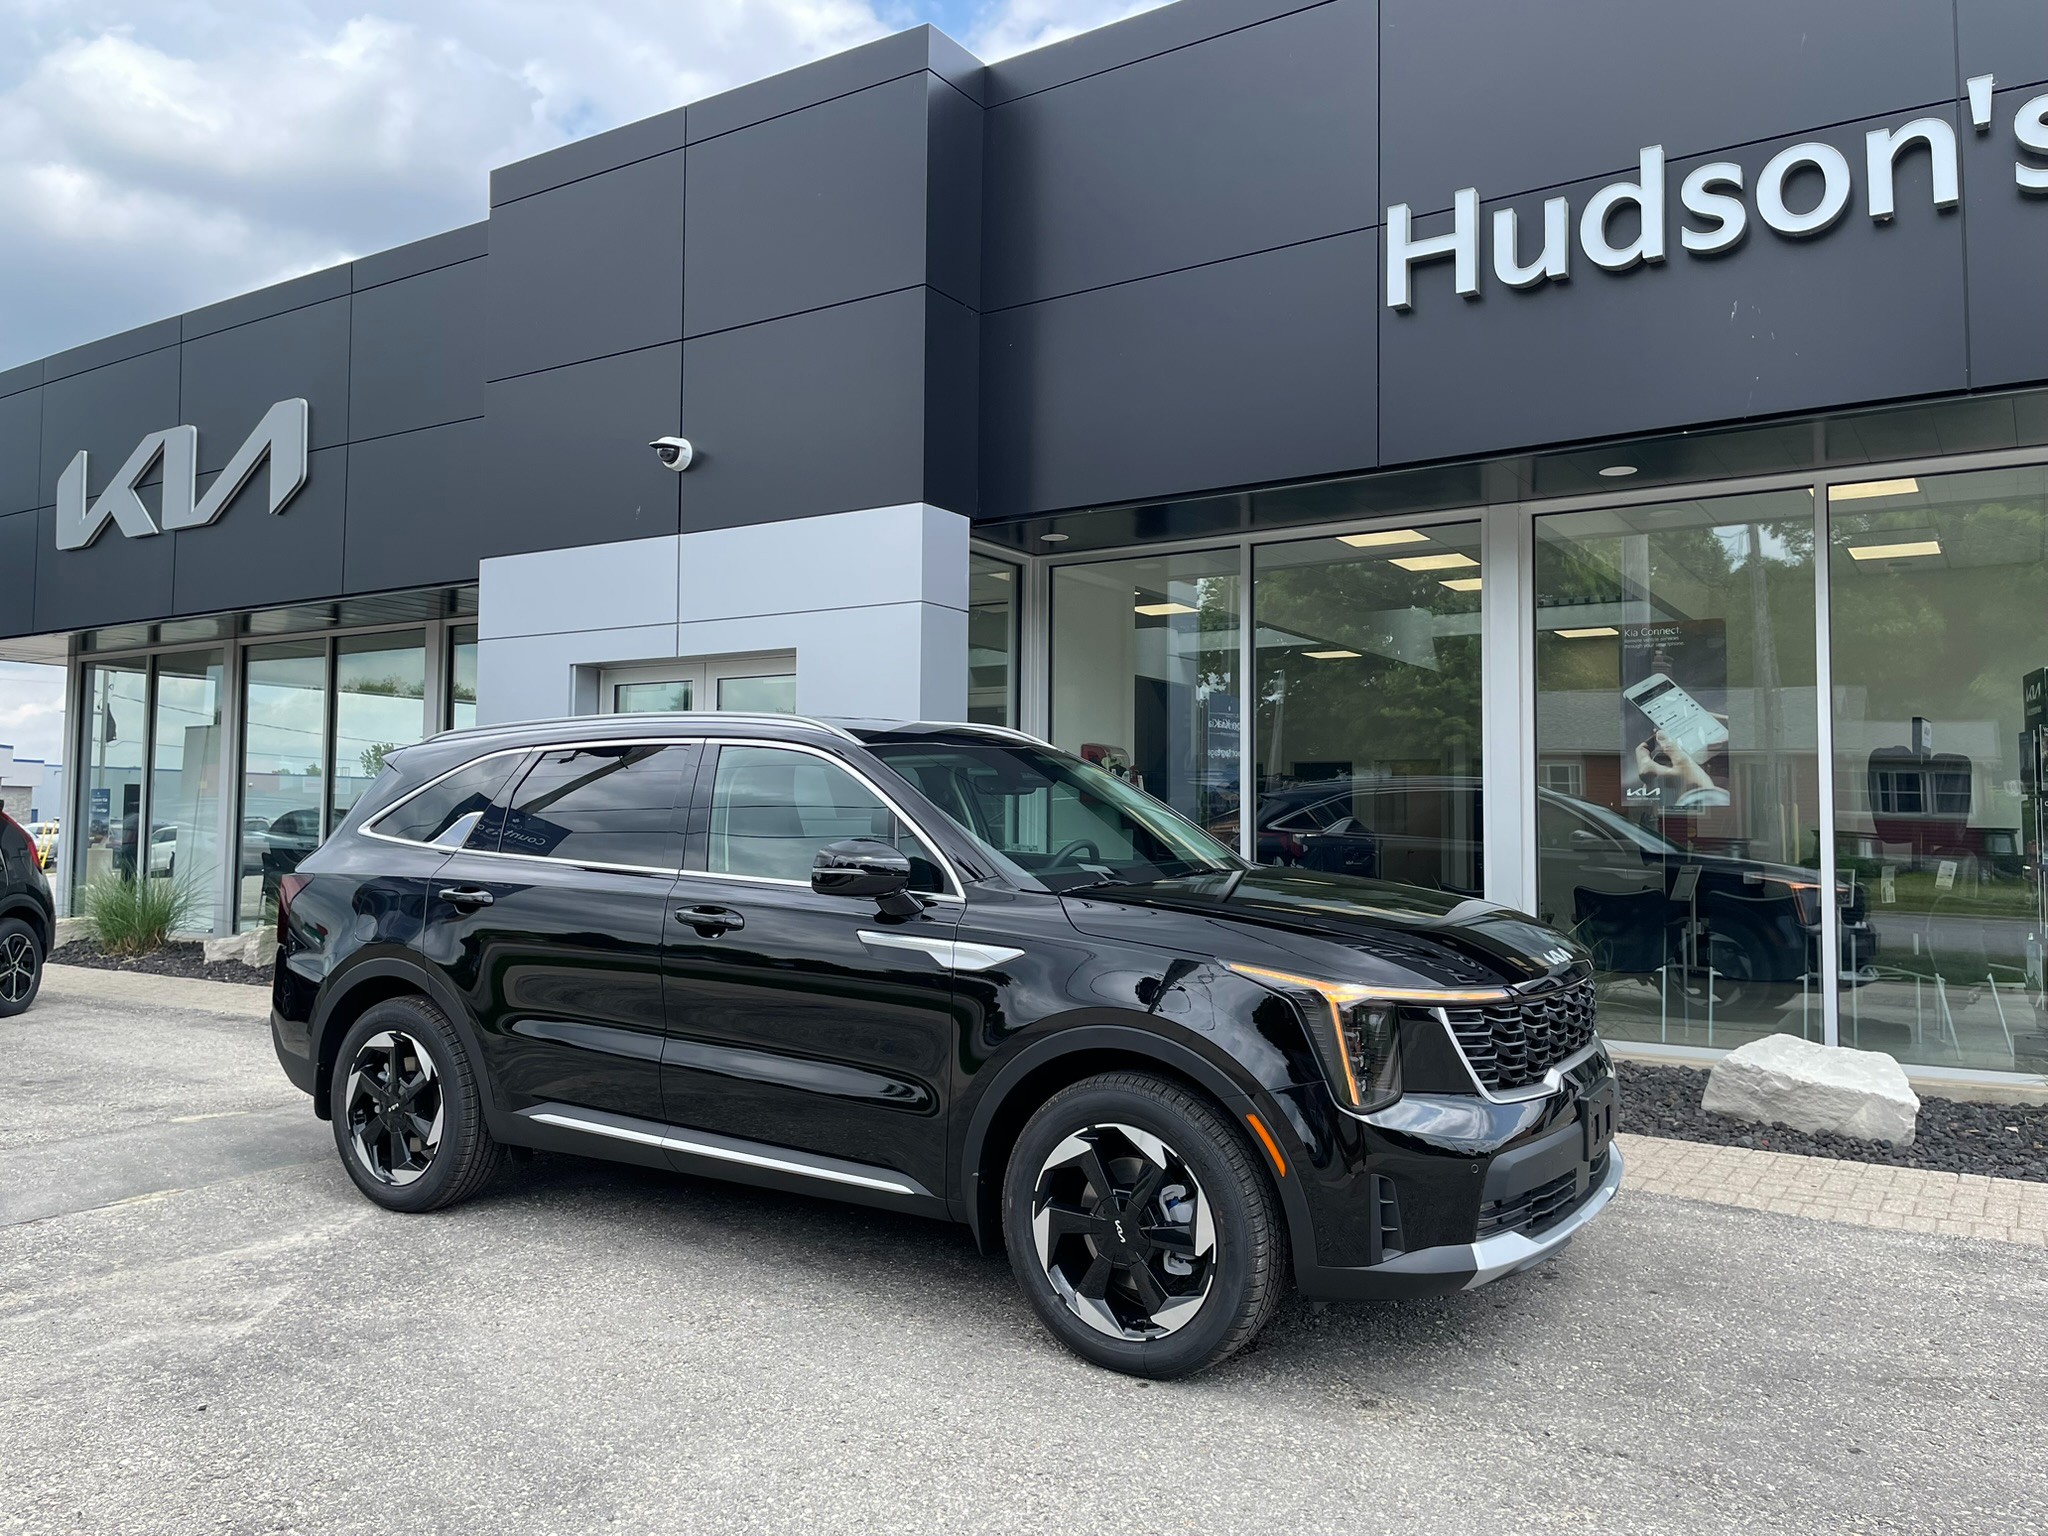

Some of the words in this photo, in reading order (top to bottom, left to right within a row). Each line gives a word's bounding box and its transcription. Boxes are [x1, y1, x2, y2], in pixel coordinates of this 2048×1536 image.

[56, 398, 308, 551] KIA
[1624, 629, 1639, 637] Kia
[1626, 787, 1661, 796] KIA
